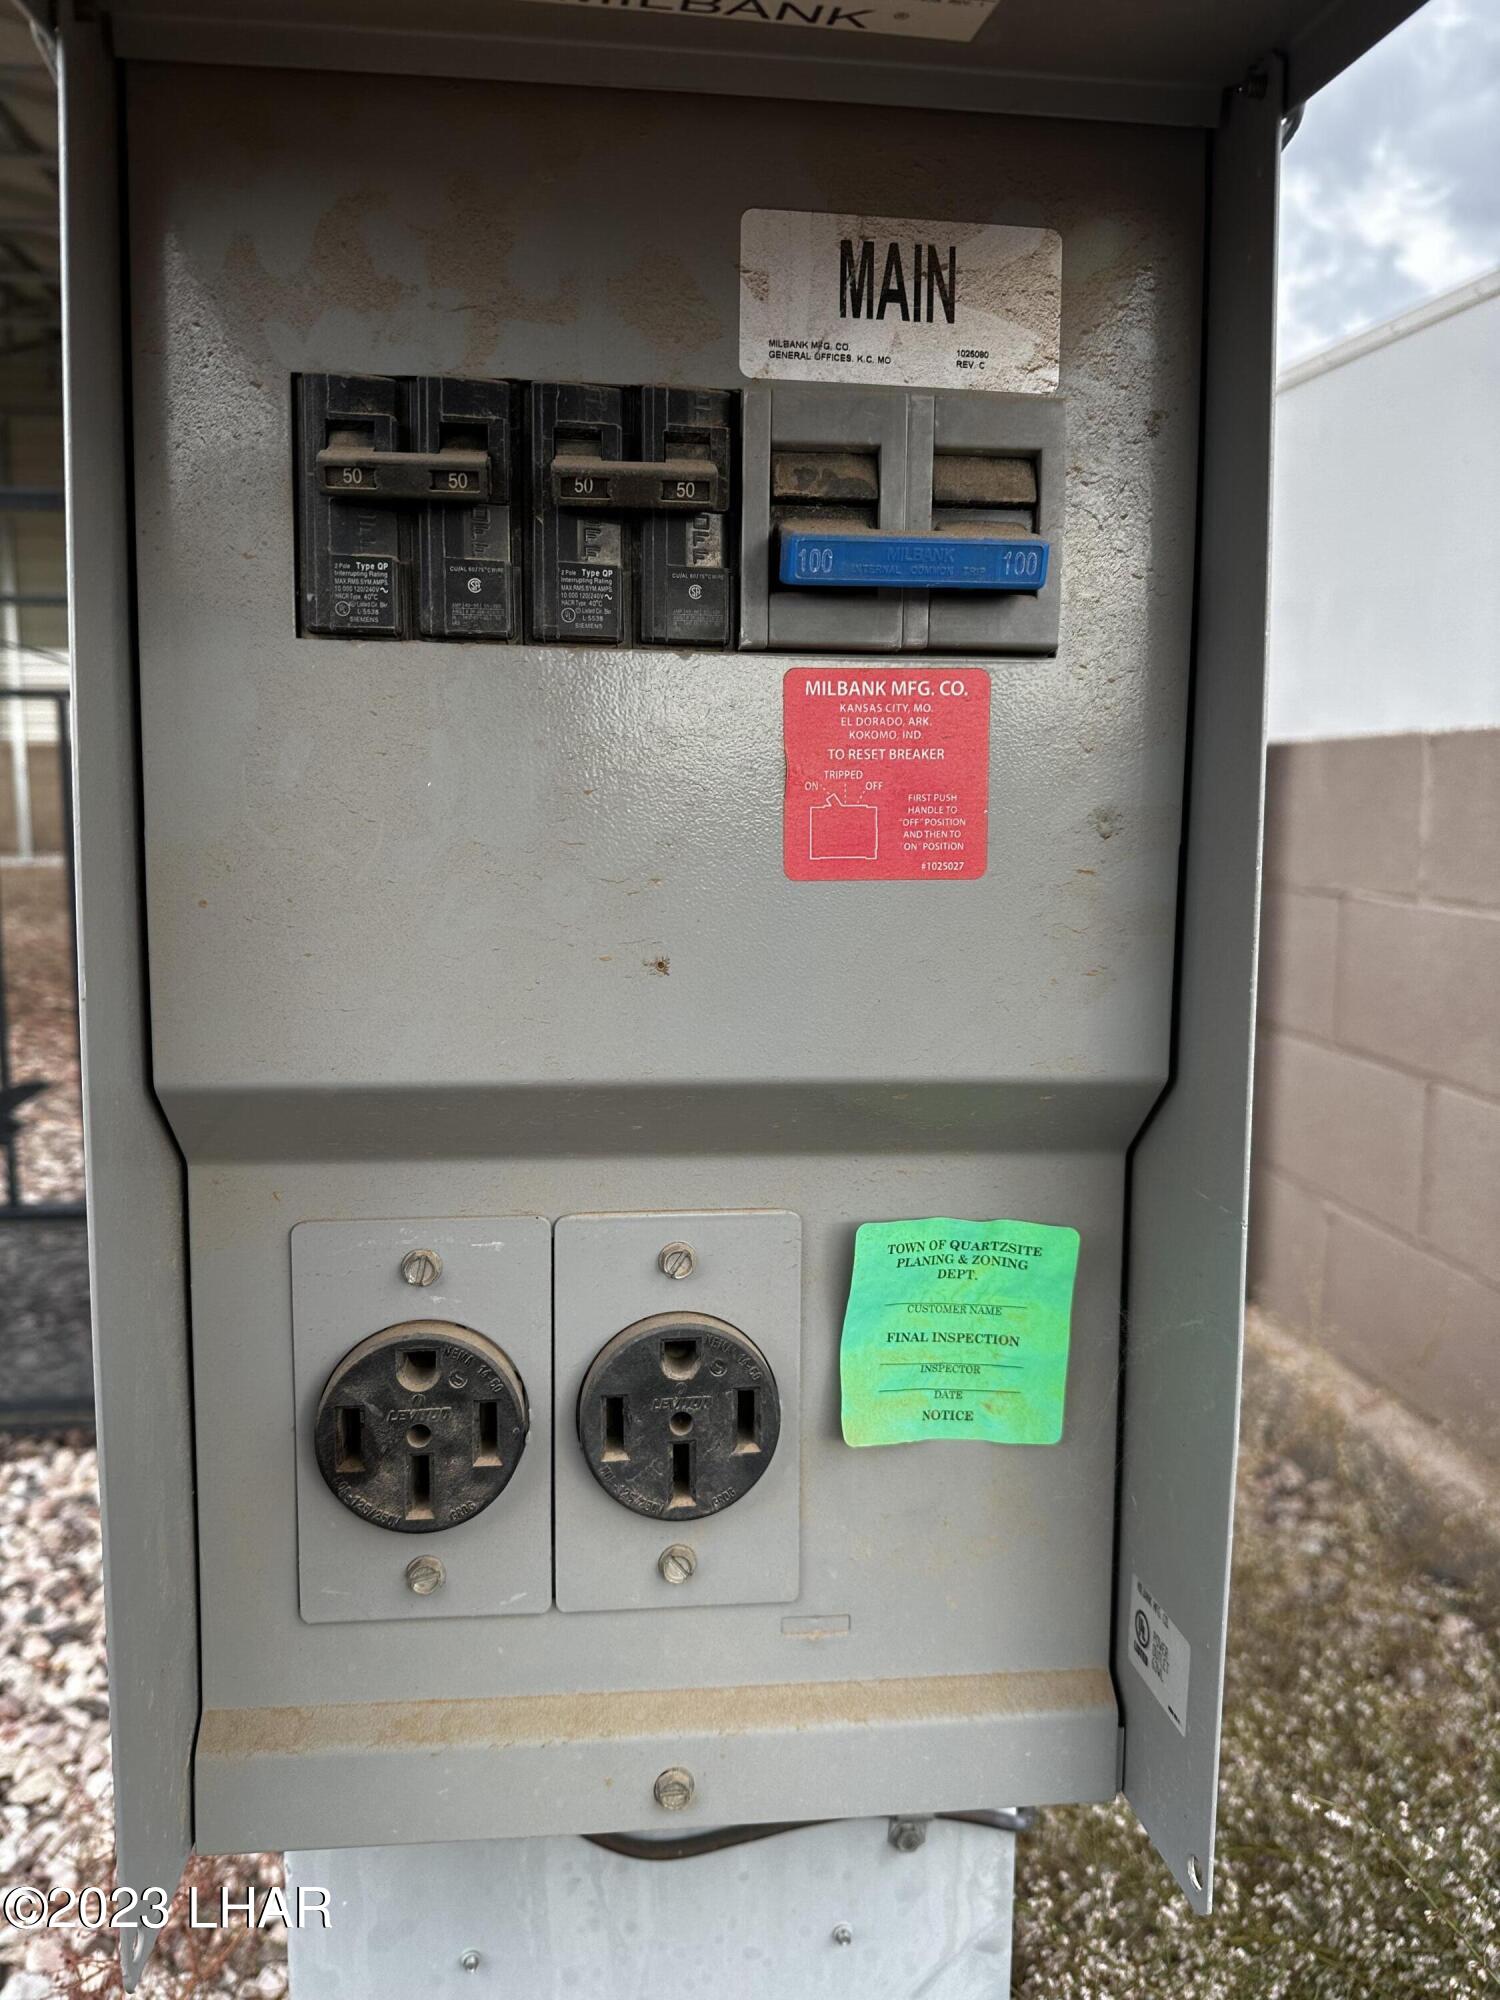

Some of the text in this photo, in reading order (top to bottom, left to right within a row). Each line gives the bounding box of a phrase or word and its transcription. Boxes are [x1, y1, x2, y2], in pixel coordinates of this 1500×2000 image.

[572, 0, 874, 28] LBANK
[840, 239, 956, 324] MAIN
[768, 339, 808, 349] MILBANK
[769, 350, 811, 361] GENERAL
[979, 361, 986, 370] C
[343, 468, 362, 484] 50
[448, 473, 468, 489] 50
[574, 478, 594, 494] 50
[676, 482, 696, 498] 50
[693, 514, 710, 565] OFF
[887, 547, 956, 563] MILBANK
[798, 548, 834, 574] 100
[1003, 551, 1039, 576] 100
[356, 562, 375, 572] Type
[377, 562, 389, 571] QP
[910, 564, 955, 576] COMMON
[334, 570, 389, 579] Interrupting Rating
[582, 569, 600, 578] Type
[602, 569, 614, 577] QP
[561, 577, 613, 586] Interrupting Rating
[805, 681, 969, 697] MILBANK MFG. CO.
[840, 704, 934, 715] KANSAS CITY, MO.
[841, 717, 933, 728] EL DORADO, ARK.
[828, 749, 945, 760] TO RESET BREAKER
[824, 771, 864, 780] TRIPPED
[805, 782, 819, 791] ON
[865, 782, 884, 791] OFF
[908, 794, 958, 802] FIRST PUSH
[908, 806, 958, 814] HANDLE TO
[924, 818, 966, 827] POSITION
[904, 831, 962, 839] AND THEN TO
[923, 843, 964, 851] POSITION
[921, 862, 965, 871] #1025027
[888, 1240, 1043, 1257] TOWN OF QUARTZSITE
[897, 1254, 1029, 1271] PLANING & ZONING
[937, 1269, 978, 1281] DEPT.
[907, 1304, 1003, 1316] CUSTOMER NAME
[886, 1332, 1020, 1347] FINAL INSPECTION
[920, 1364, 981, 1375] INSPECTOR
[934, 1389, 963, 1400] DATE
[922, 1410, 975, 1422] NOTICE
